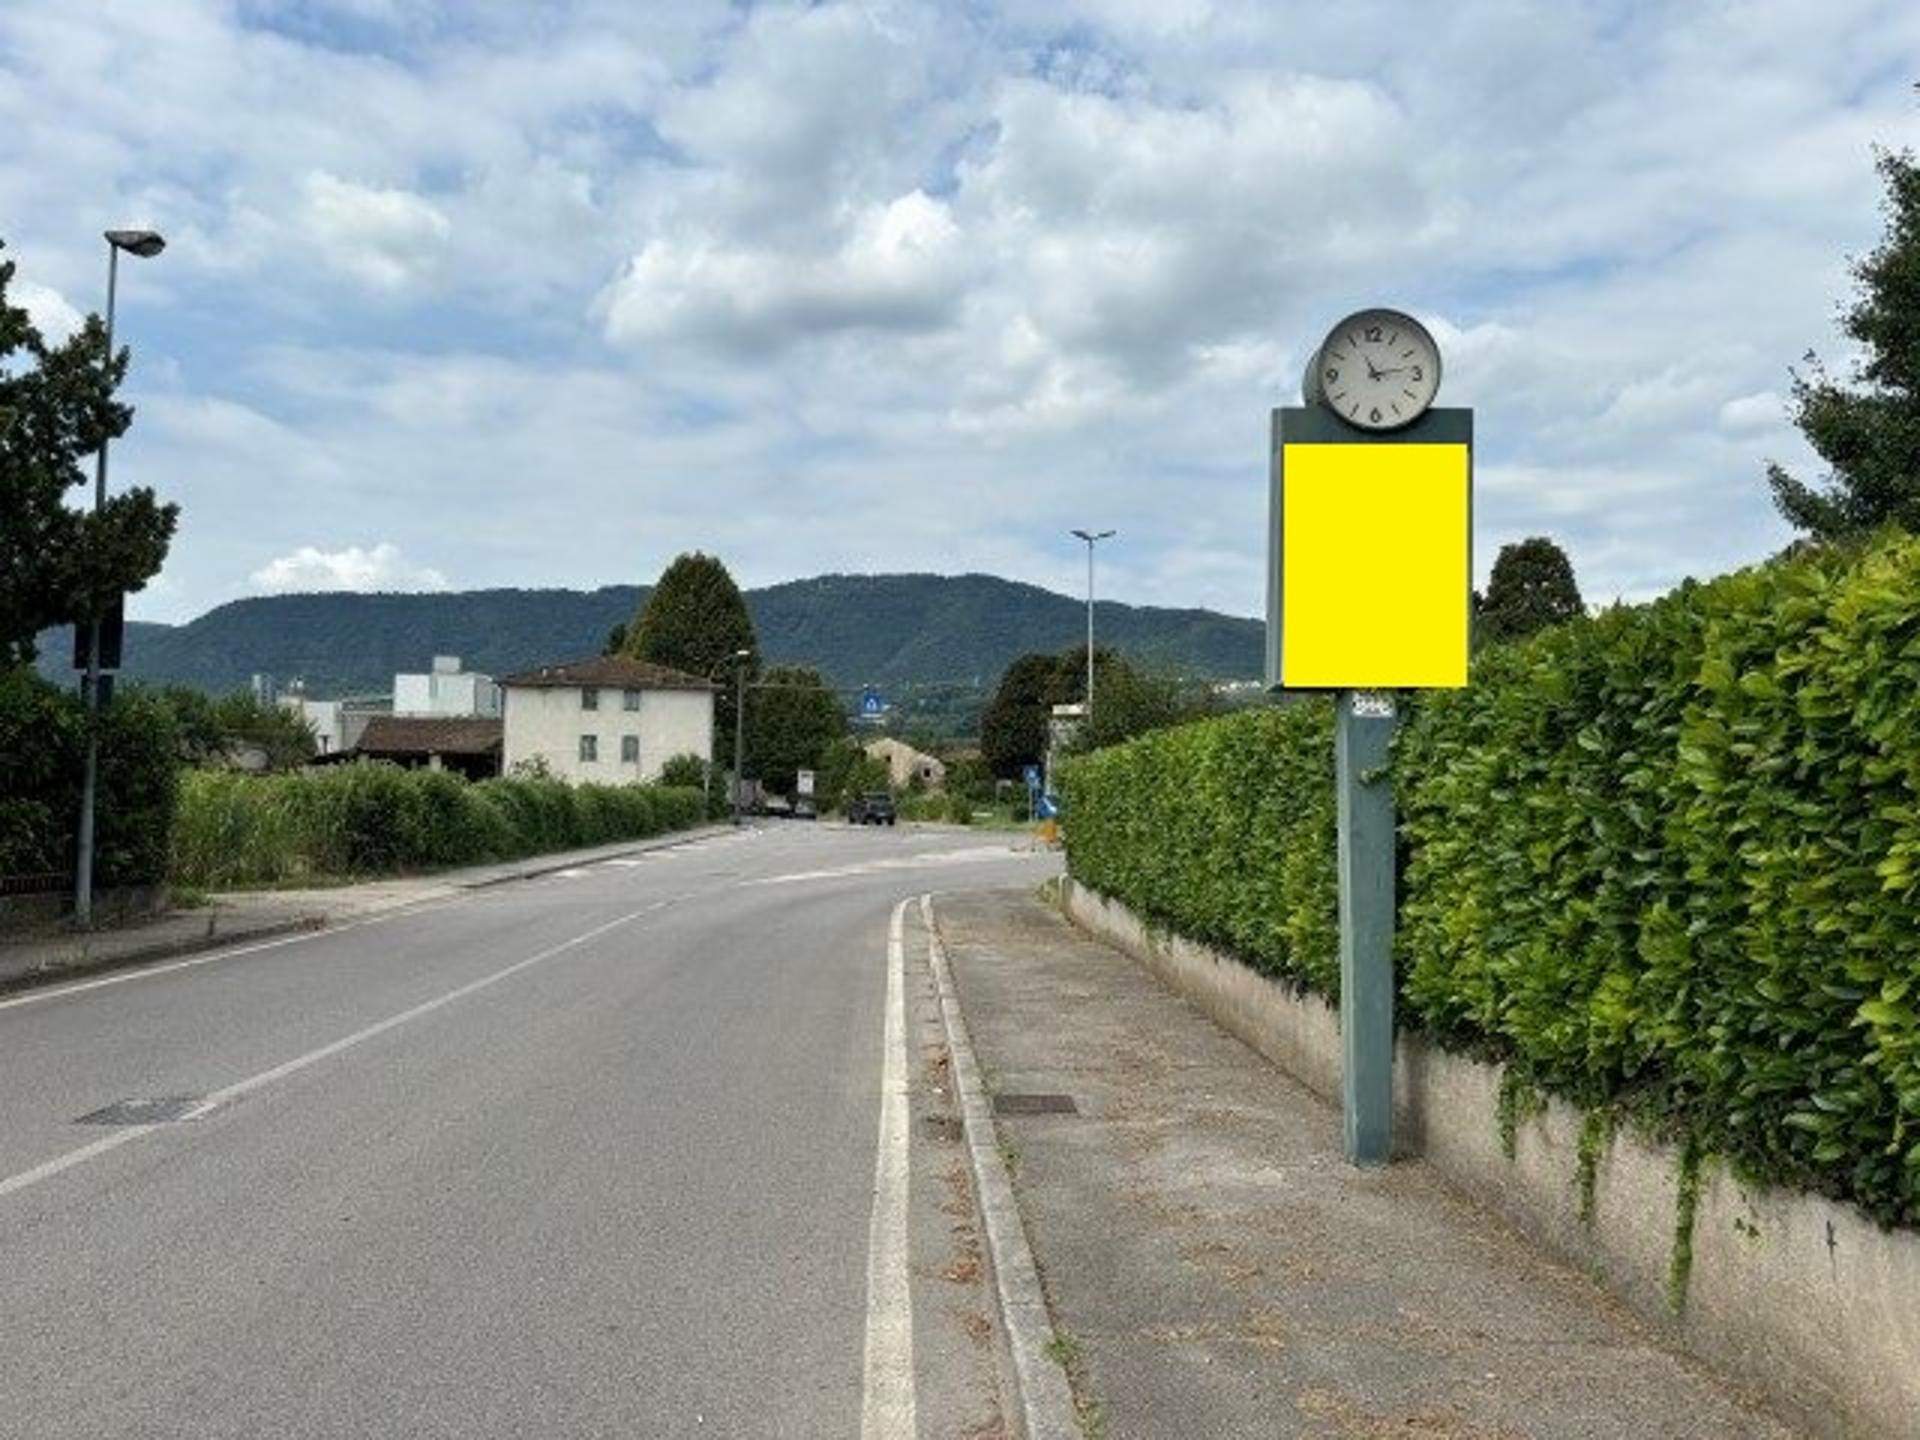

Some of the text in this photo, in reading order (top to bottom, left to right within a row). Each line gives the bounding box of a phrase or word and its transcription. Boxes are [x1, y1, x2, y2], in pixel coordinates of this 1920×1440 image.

[1365, 326, 1383, 342] 12
[1326, 369, 1339, 384] 9
[1412, 366, 1422, 382] 3
[1370, 408, 1382, 423] 6
